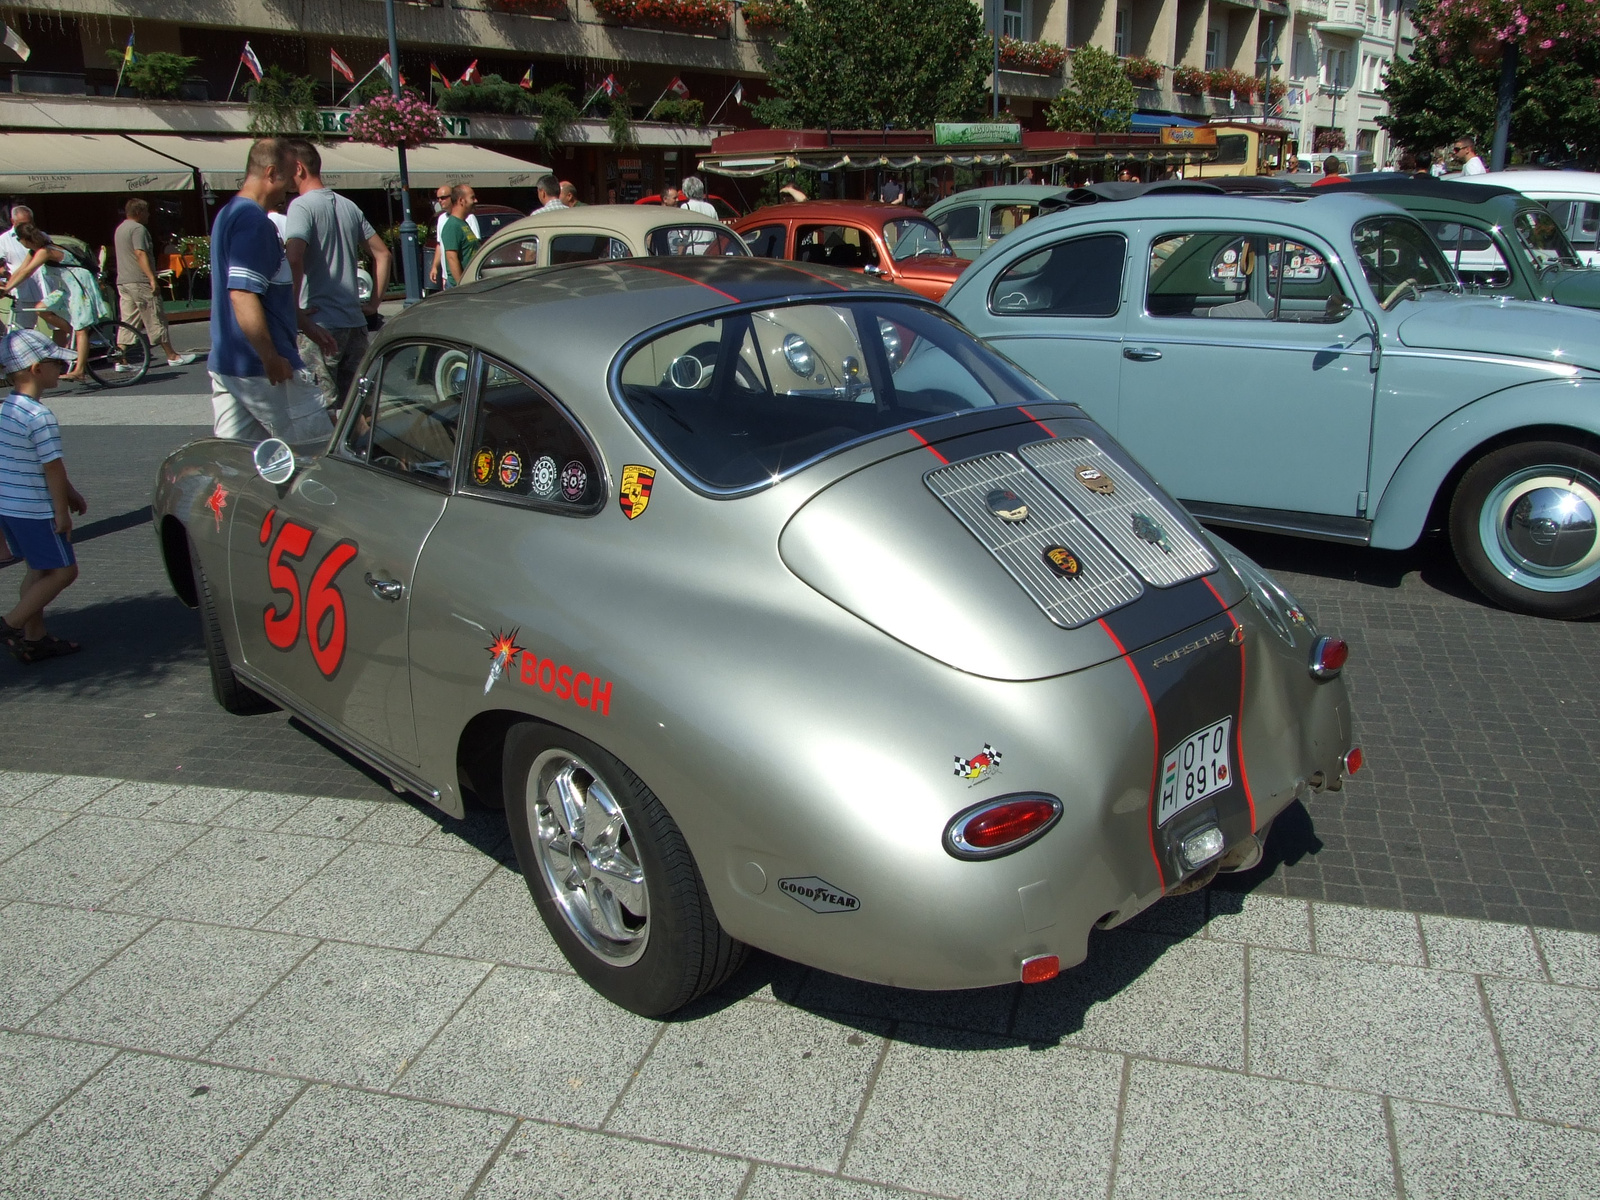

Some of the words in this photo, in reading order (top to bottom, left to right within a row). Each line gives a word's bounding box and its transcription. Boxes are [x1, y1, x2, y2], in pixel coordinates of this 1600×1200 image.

[624, 466, 655, 477] PORSCHE
[1153, 629, 1226, 669] PORSCHE
[519, 651, 613, 716] BOSCH
[1162, 785, 1174, 811] H
[1185, 758, 1217, 801] 891
